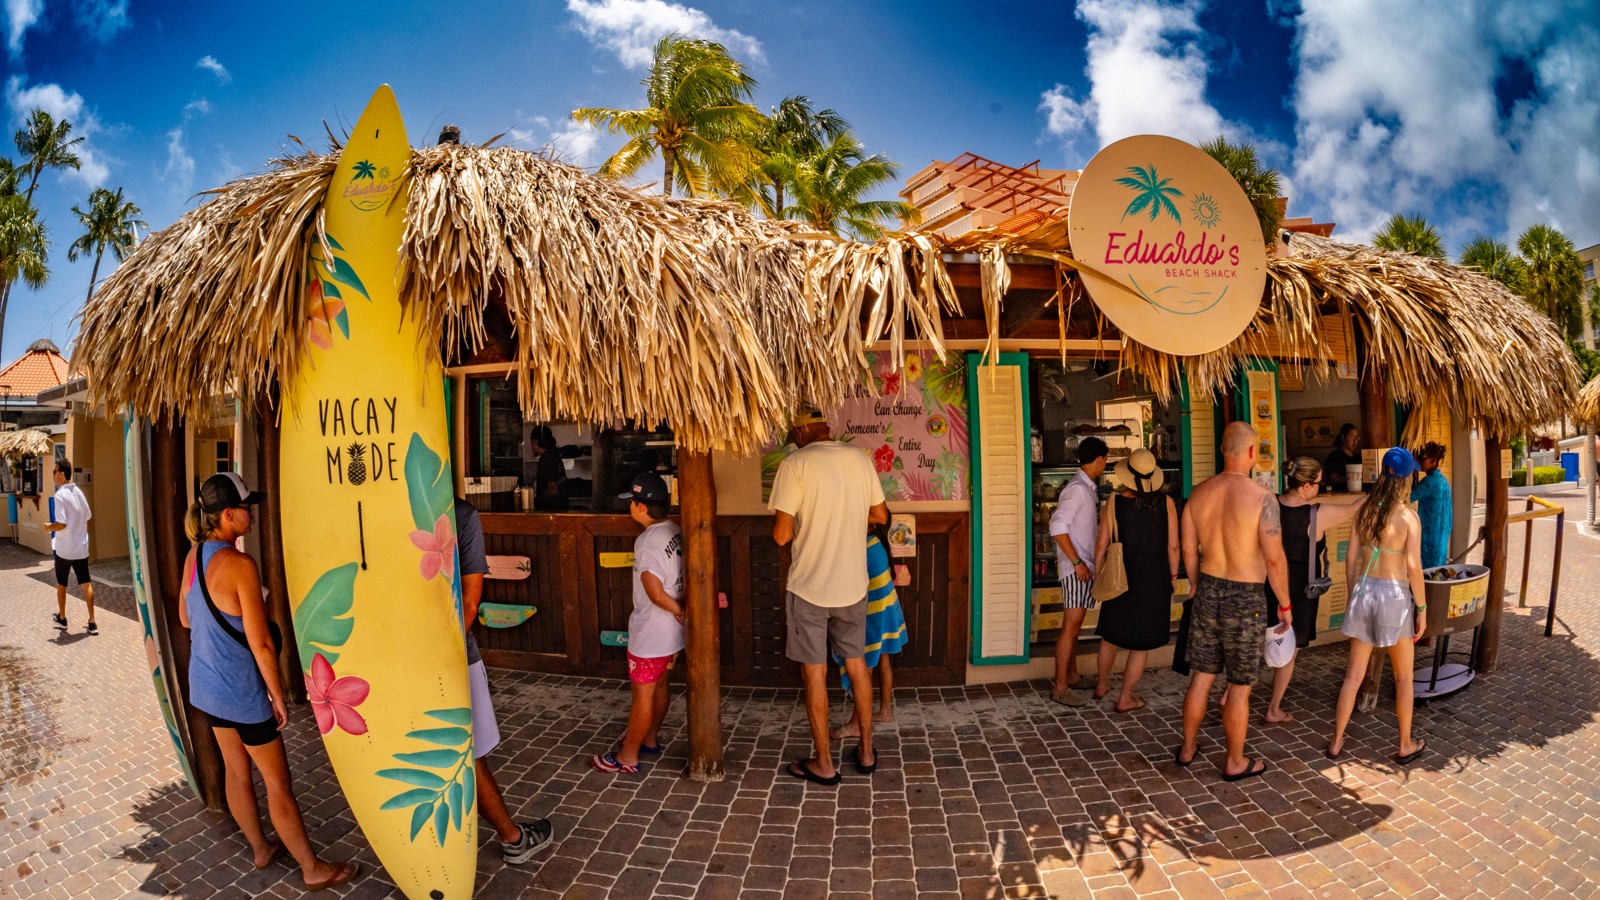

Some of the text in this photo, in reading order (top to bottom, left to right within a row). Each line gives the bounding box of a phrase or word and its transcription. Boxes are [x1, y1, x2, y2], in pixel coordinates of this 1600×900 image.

[343, 181, 397, 199] Eduardo's
[1104, 229, 1240, 266] Eduardo's
[1165, 268, 1237, 278] BEACH SHACK
[318, 396, 397, 437] VACAY
[874, 401, 923, 420] Can Change
[845, 419, 886, 435] Someone's
[898, 436, 922, 451] Entire
[917, 453, 936, 473] Day
